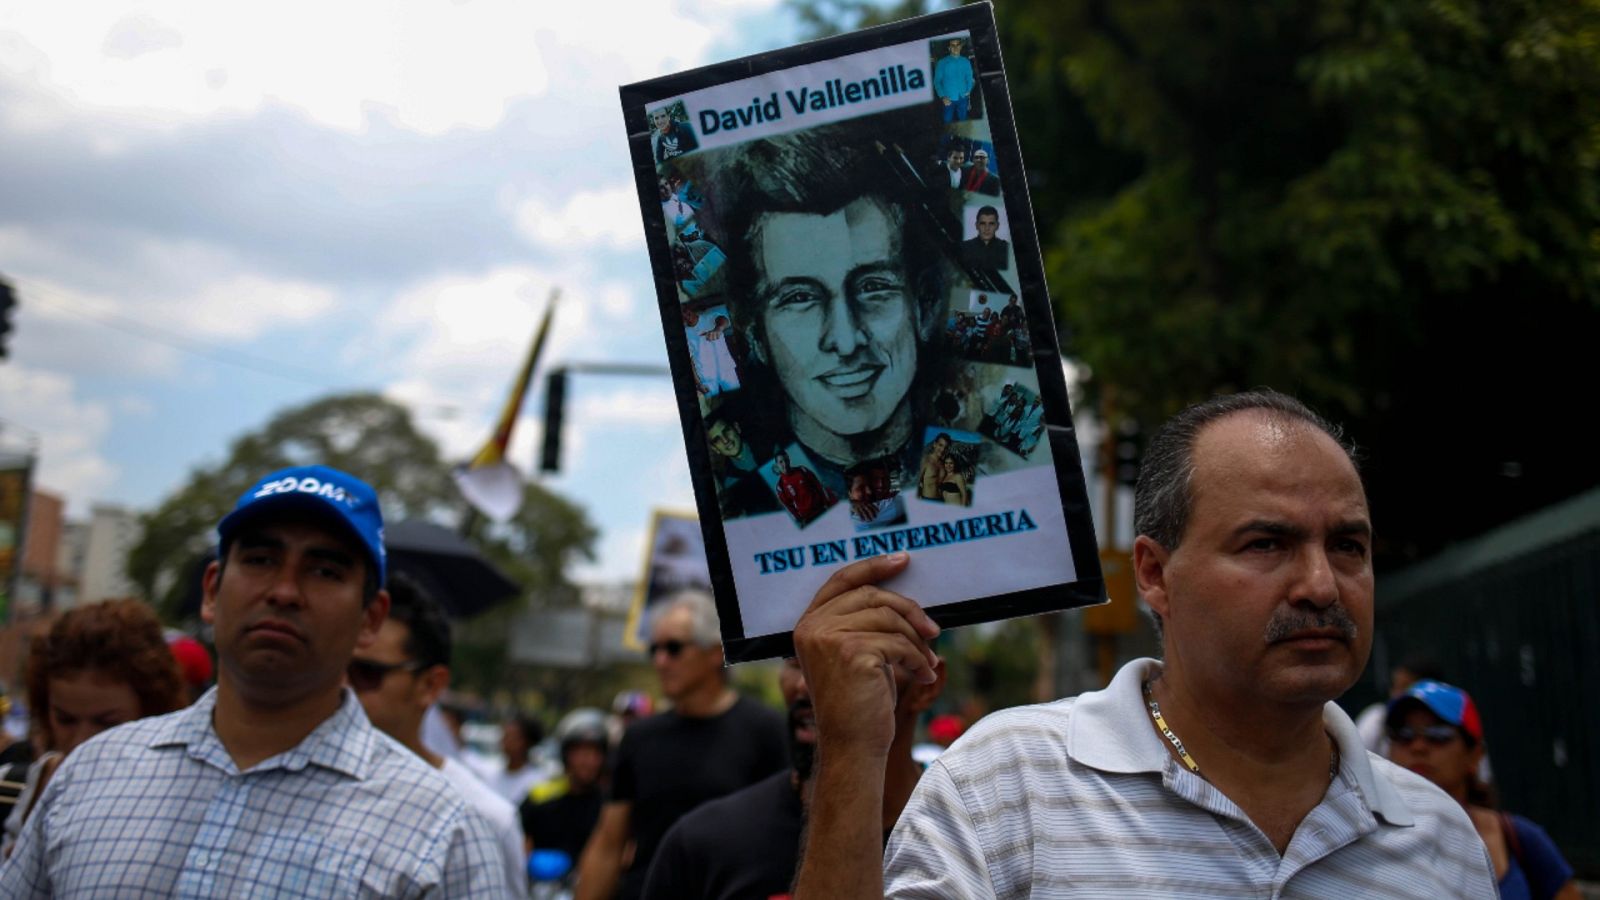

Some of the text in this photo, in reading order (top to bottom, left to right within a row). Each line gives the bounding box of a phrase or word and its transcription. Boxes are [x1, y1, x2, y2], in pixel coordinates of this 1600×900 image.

[699, 64, 925, 135] David Vallenilla
[753, 508, 1038, 575] TSU EN ENFERMERIA
